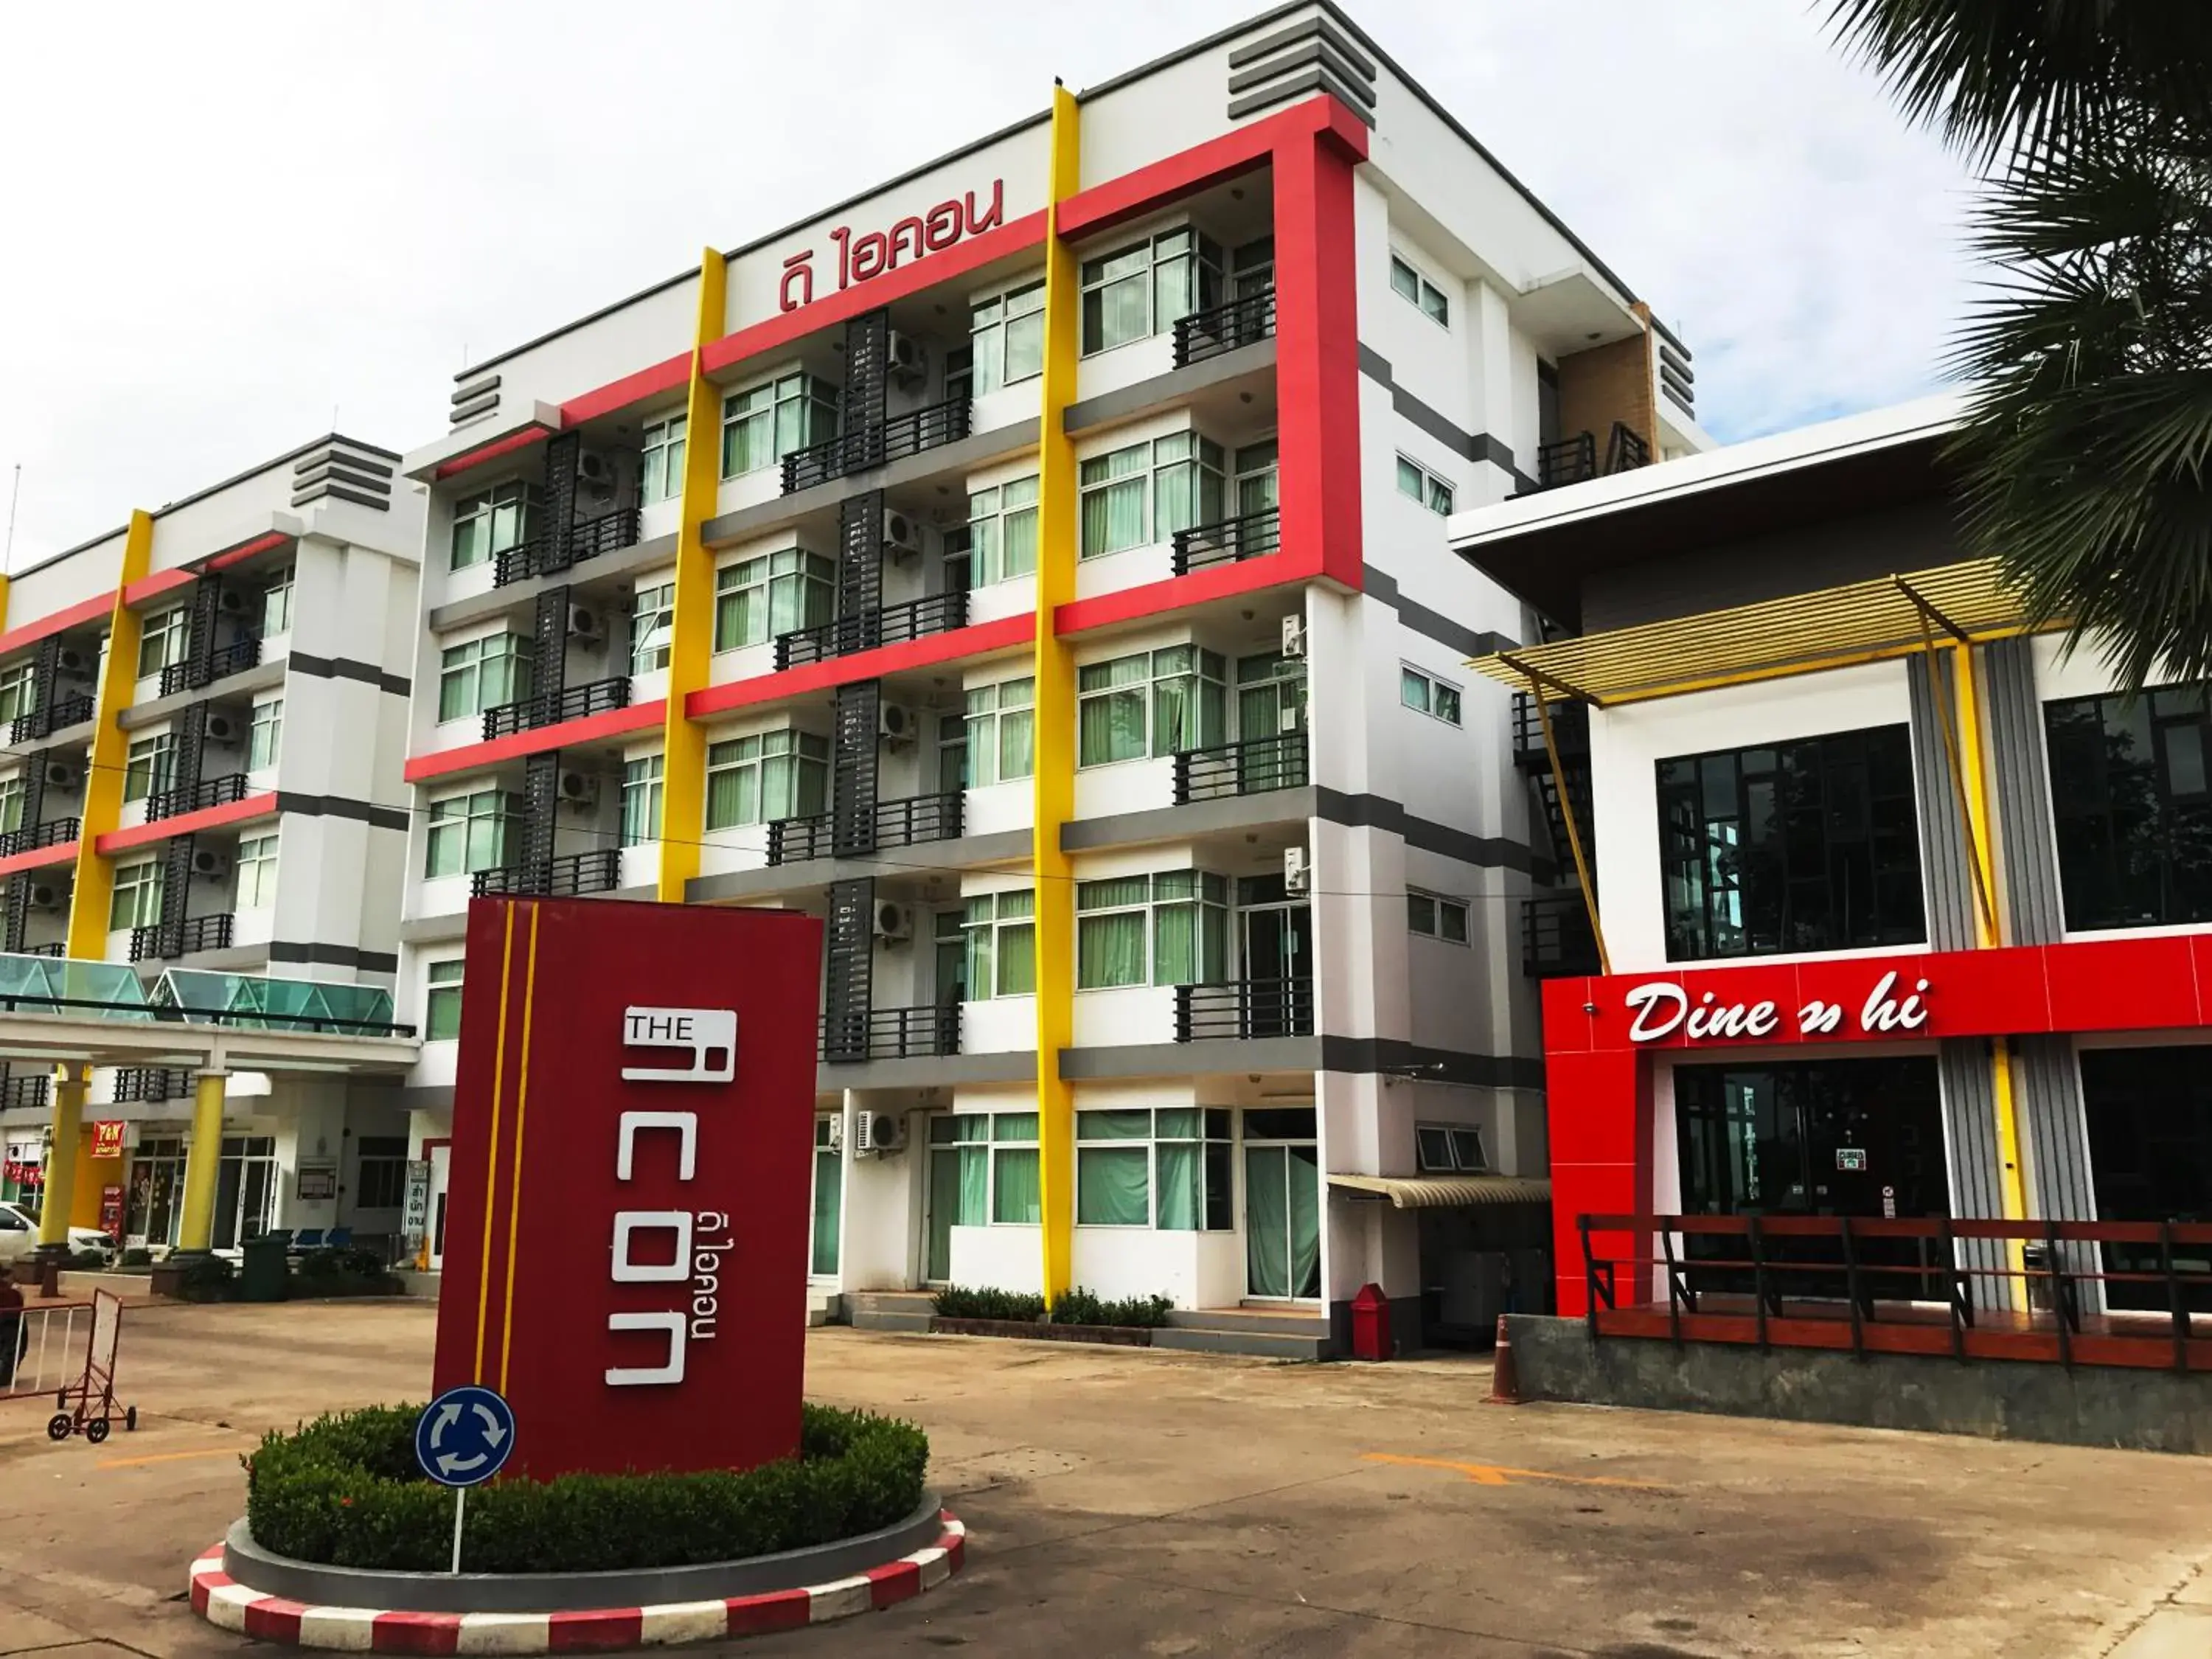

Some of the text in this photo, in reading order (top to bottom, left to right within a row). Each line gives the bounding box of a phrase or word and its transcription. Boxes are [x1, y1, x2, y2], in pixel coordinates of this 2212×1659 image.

[830, 178, 1004, 290] ไอคอน
[627, 1015, 694, 1040] THE
[1626, 983, 1778, 1042] Dine
[1861, 971, 1930, 1032] hi
[691, 1238, 734, 1339] ไอคอน
